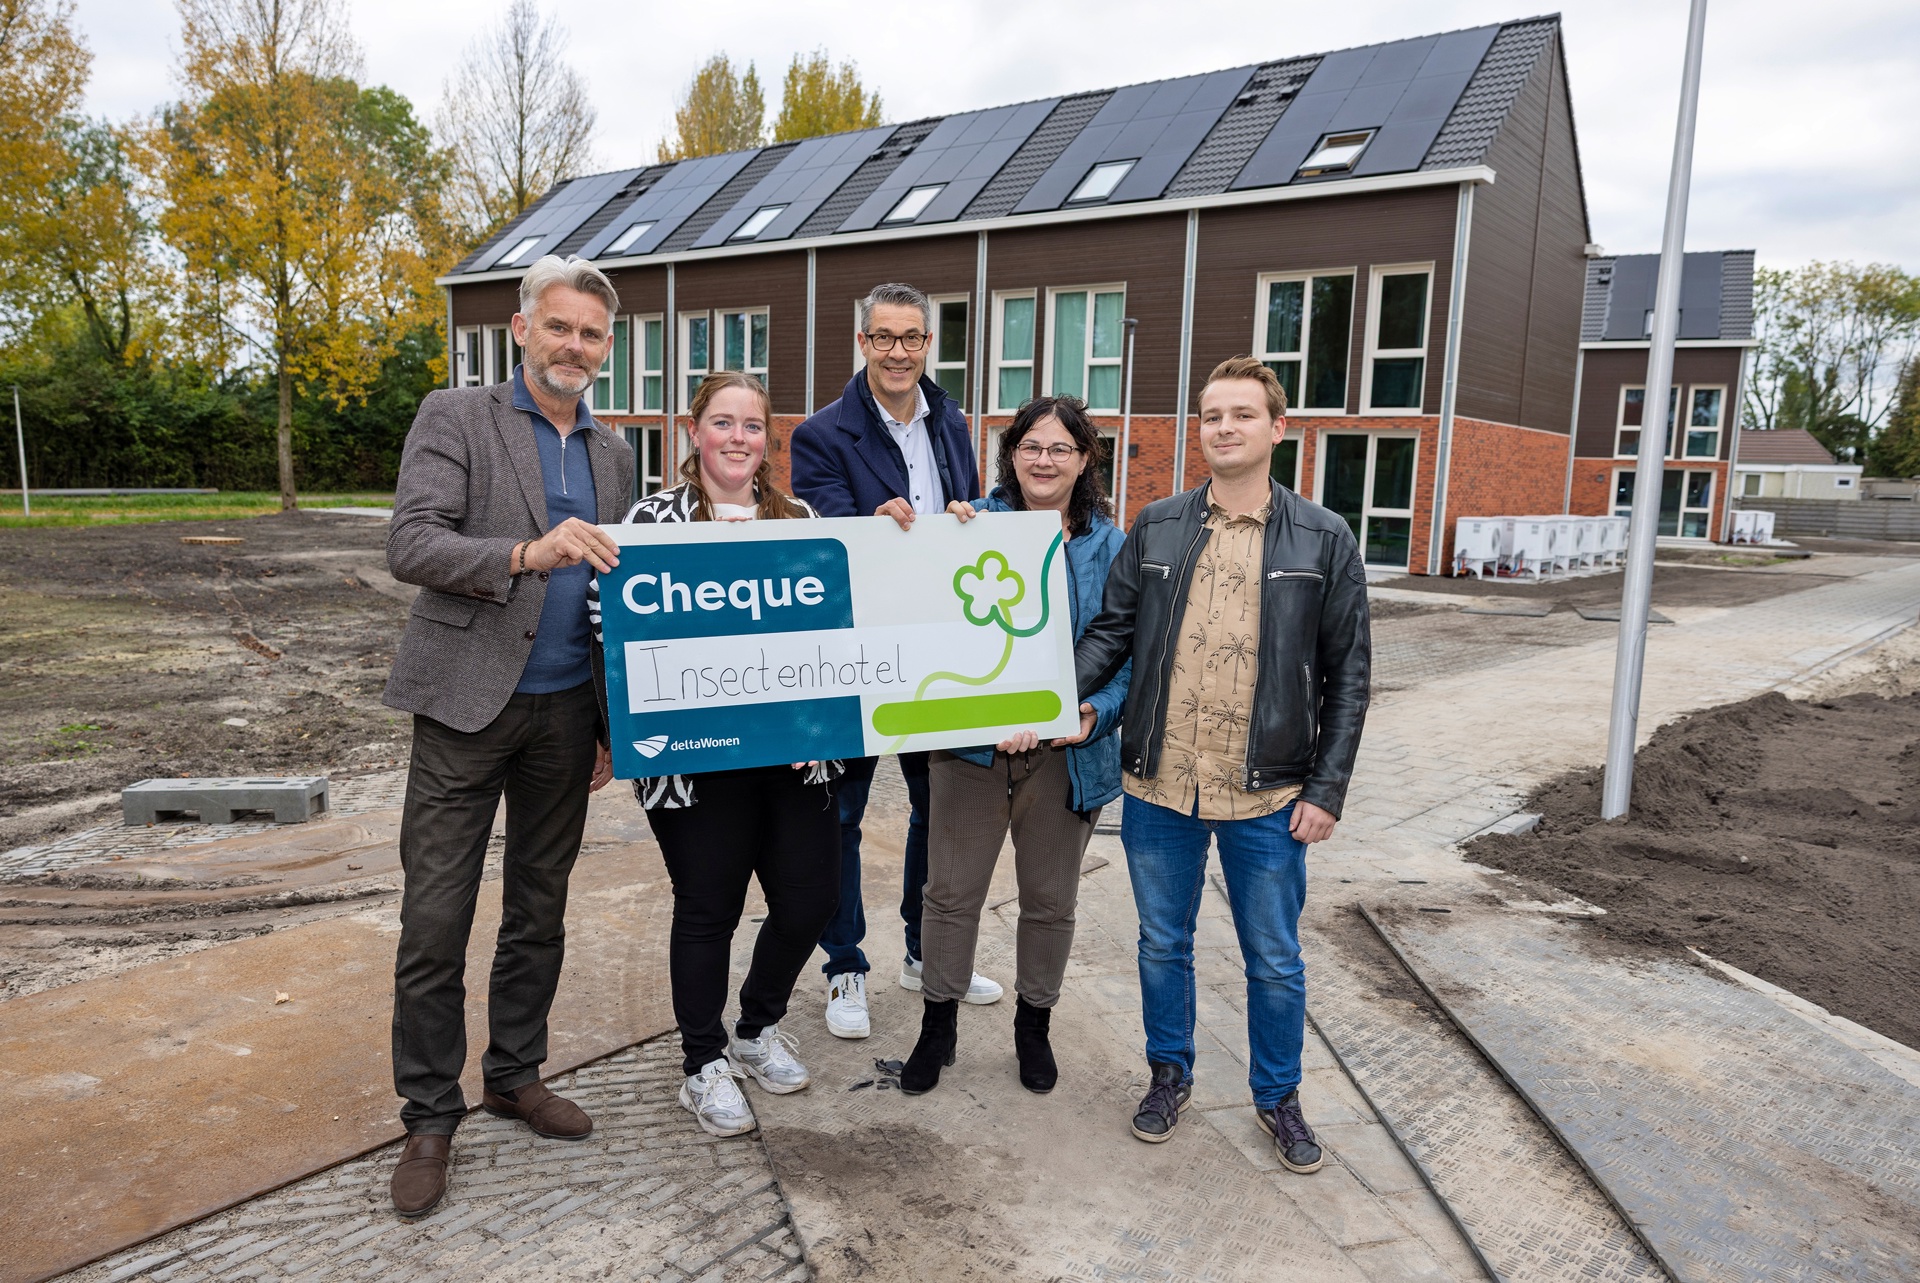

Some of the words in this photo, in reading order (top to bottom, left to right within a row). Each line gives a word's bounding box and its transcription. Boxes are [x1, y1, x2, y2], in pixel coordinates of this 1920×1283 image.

[622, 572, 825, 621] Cheque
[639, 643, 907, 703] Insectenhotel
[670, 737, 740, 751] deltaWonen
